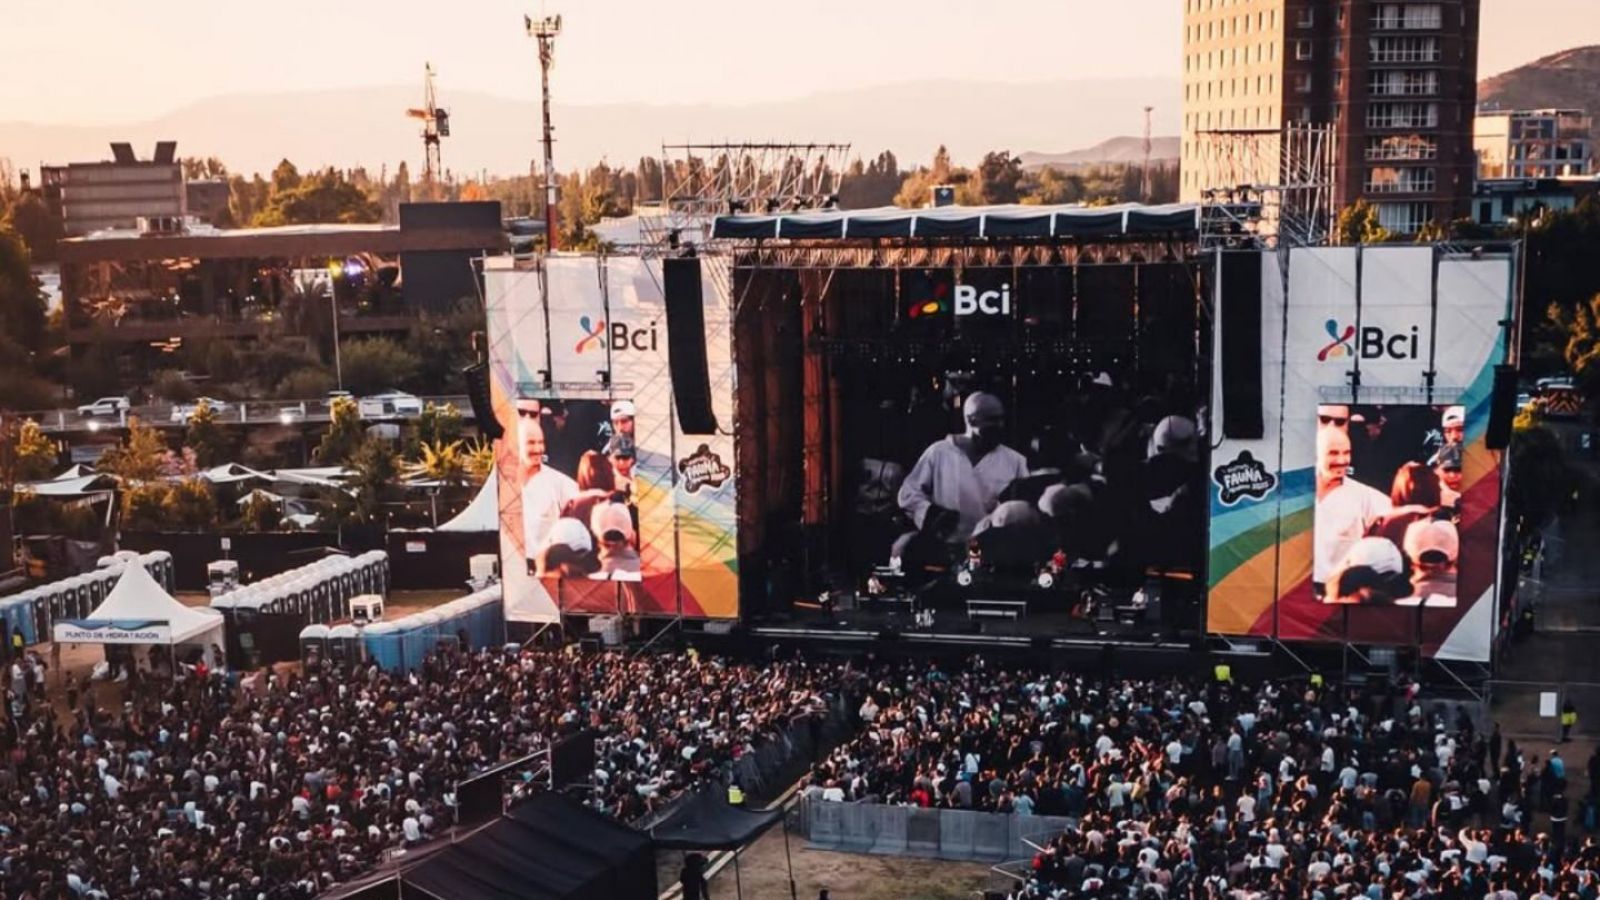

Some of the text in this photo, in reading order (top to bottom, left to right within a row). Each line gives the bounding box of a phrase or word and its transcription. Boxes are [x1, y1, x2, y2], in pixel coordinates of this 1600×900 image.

[955, 283, 1010, 315] Bci
[611, 321, 657, 351] Bci
[1361, 325, 1418, 359] Bci
[1224, 467, 1263, 490] FAUNA
[65, 631, 92, 639] PUNTO
[93, 631, 104, 639] DE
